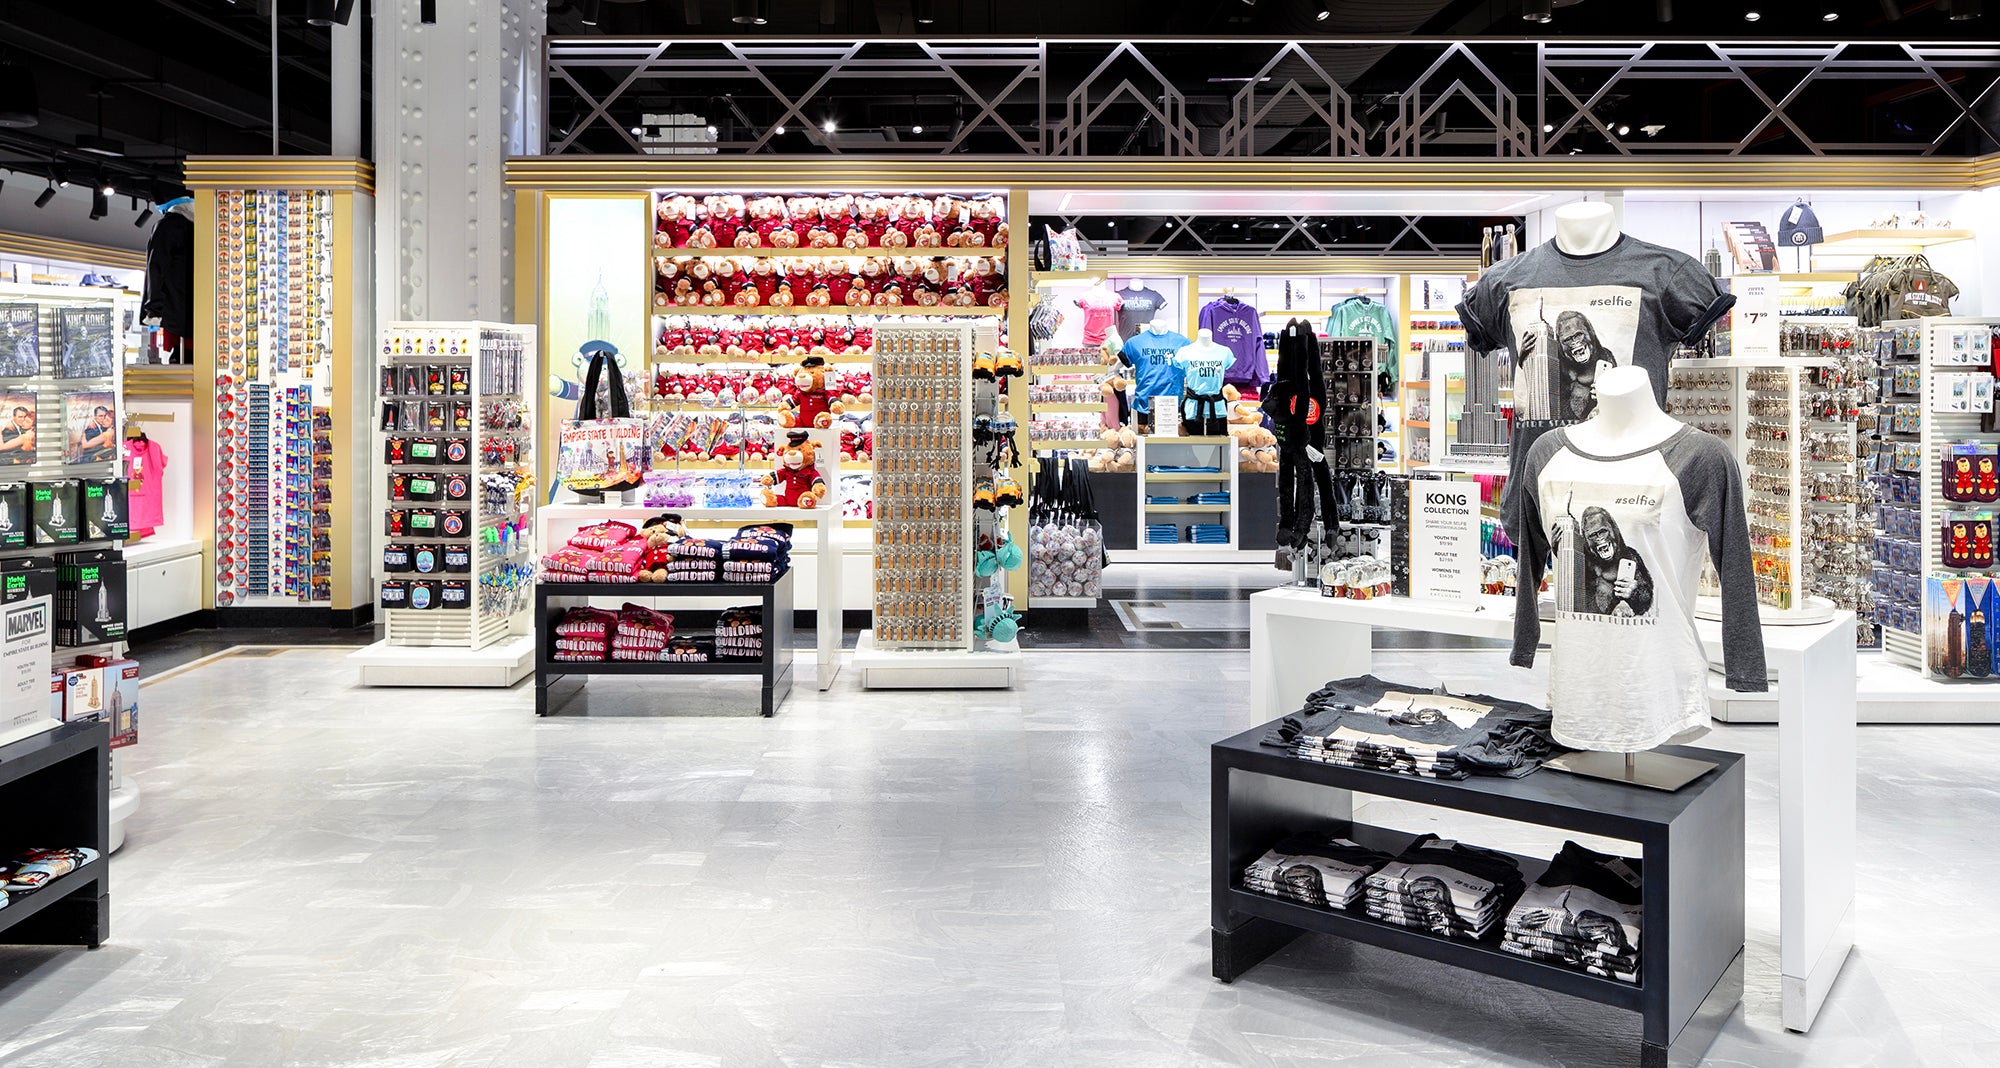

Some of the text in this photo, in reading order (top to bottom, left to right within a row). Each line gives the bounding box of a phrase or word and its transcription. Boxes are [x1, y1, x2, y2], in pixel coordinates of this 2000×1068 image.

[1590, 296, 1633, 307] #selfie
[12, 310, 33, 322] KONG
[1142, 348, 1157, 356] NEW
[1190, 360, 1205, 368] NEW
[1199, 367, 1216, 377] CITY
[563, 427, 641, 443] EMPIRE STATE UILDING
[1426, 493, 1467, 506] KONG
[1615, 494, 1656, 506] #selfie
[1423, 506, 1469, 515] COLLECTION
[82, 566, 99, 574] Metal
[7, 575, 26, 583] Metal
[7, 580, 26, 588] Earth
[8, 610, 44, 637] MARVEL
